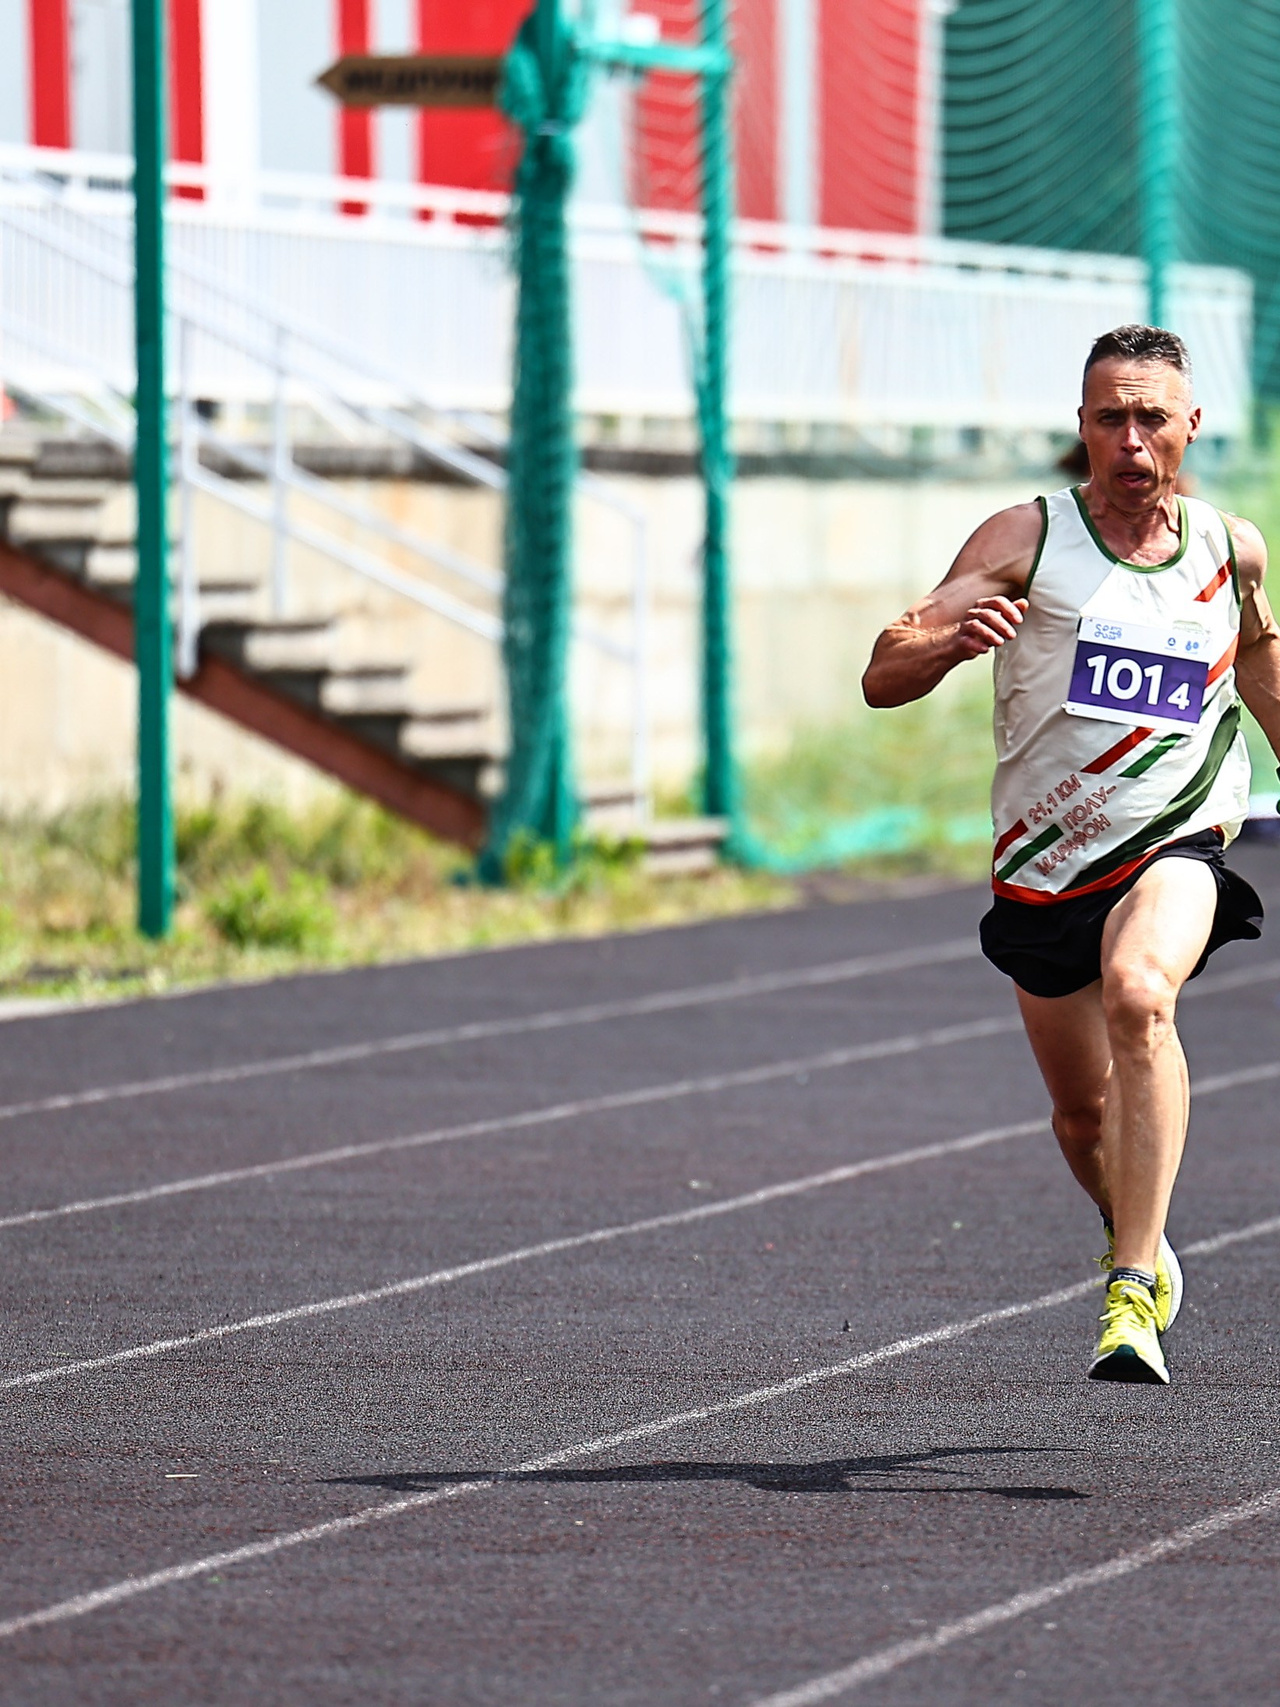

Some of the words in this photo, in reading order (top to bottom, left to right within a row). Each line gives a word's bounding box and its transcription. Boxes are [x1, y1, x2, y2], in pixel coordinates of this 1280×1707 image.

[1086, 654, 1164, 706] 101
[1167, 682, 1191, 711] 4
[1028, 793, 1058, 824] 21,1
[1054, 773, 1082, 801] КМ
[1062, 785, 1117, 830] ПОЛУ-
[1035, 813, 1111, 876] МАРАФОН
